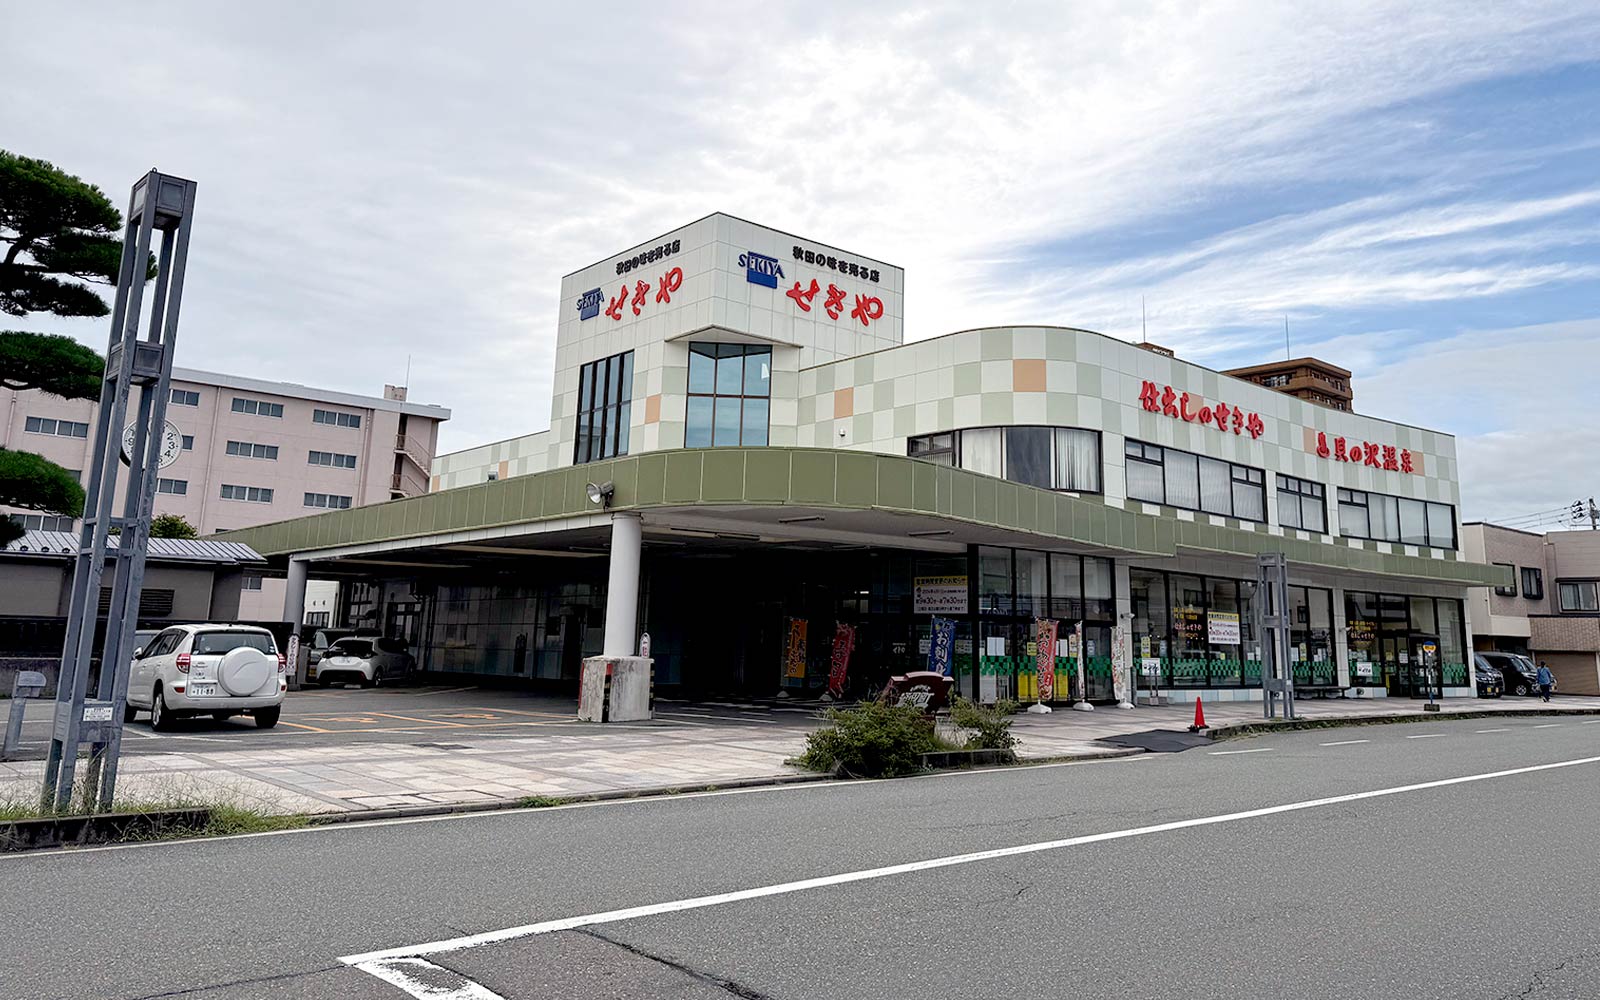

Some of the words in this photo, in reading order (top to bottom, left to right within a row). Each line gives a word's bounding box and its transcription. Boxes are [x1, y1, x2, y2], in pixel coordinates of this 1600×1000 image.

[616, 239, 681, 275] 秋田の味を売る店
[738, 253, 785, 280] SEKIYA
[792, 245, 880, 283] 秋田の味を売る店
[576, 290, 605, 311] SEKIYA
[605, 266, 683, 321] せきや
[786, 278, 884, 327] せきや
[1139, 380, 1265, 440] 仕出しのせきや
